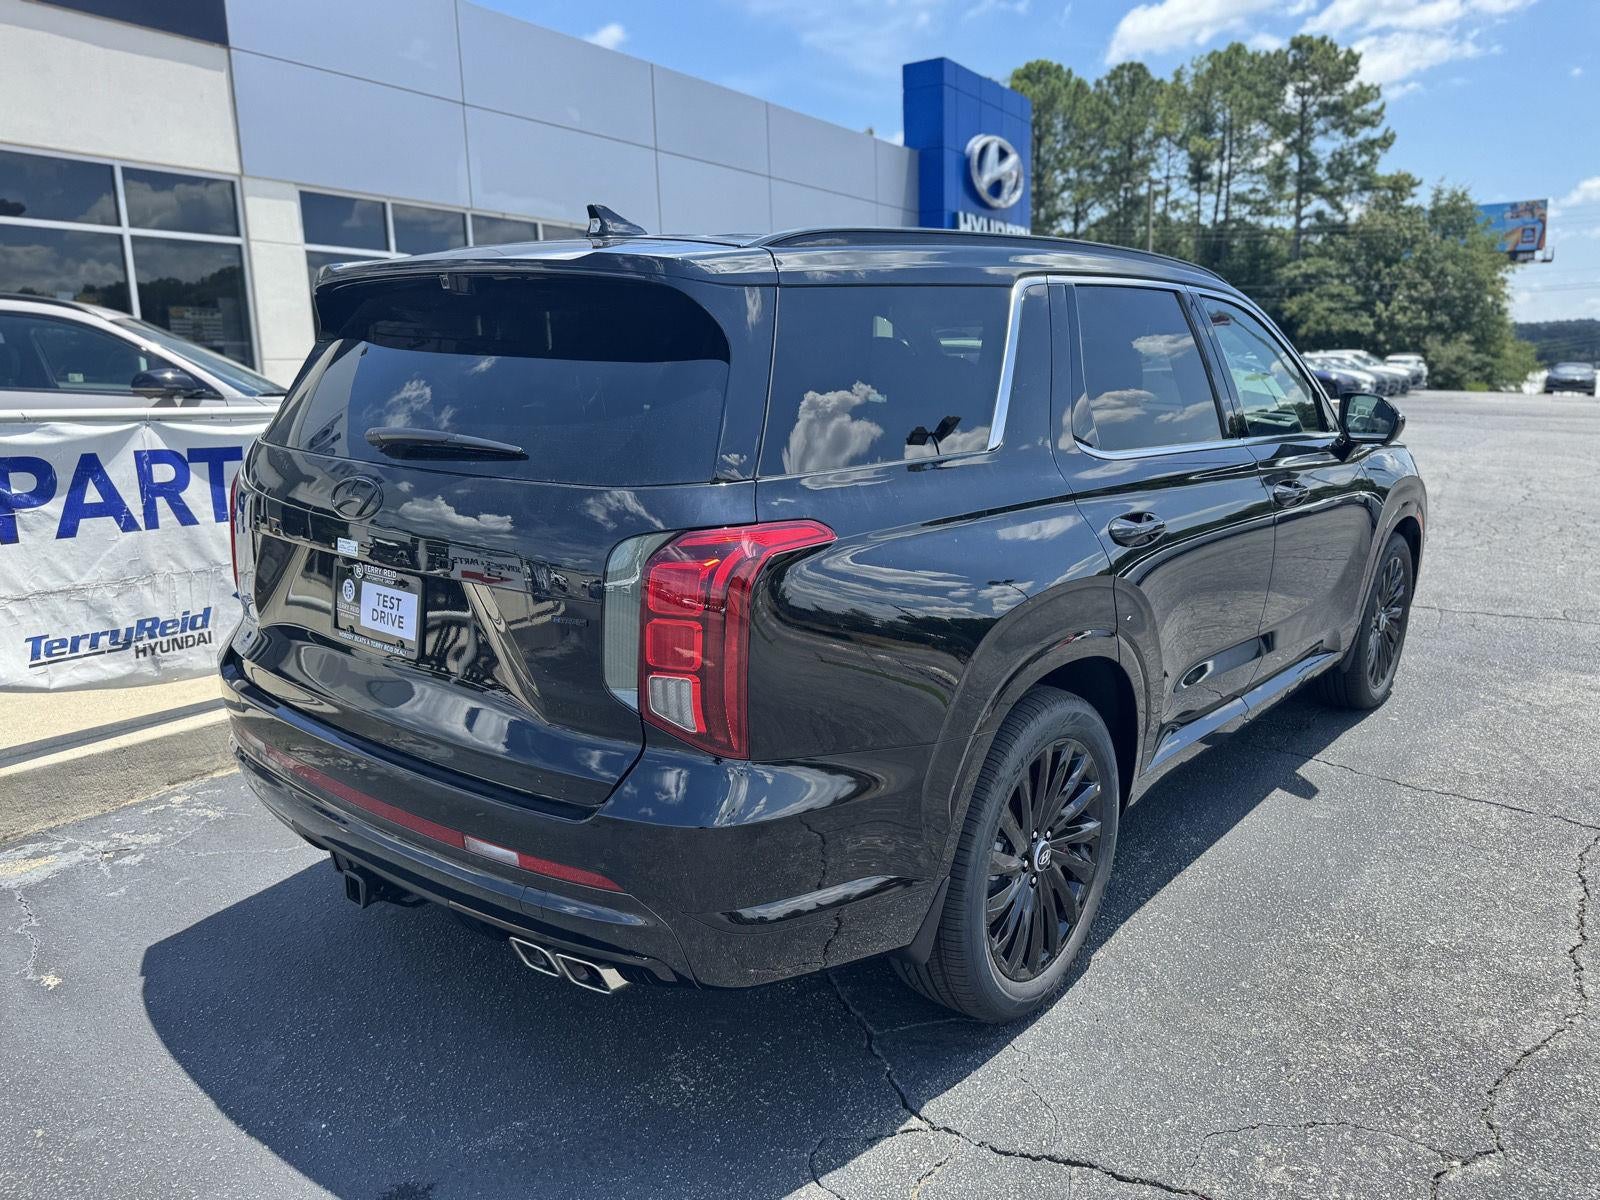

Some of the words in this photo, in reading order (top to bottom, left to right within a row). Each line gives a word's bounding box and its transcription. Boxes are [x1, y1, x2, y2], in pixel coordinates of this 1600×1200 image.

[364, 565, 382, 575] TERRY
[383, 568, 397, 579] REID
[376, 592, 403, 612] TEST
[371, 608, 405, 630] DRIVE
[135, 630, 212, 660] HYUNDAI
